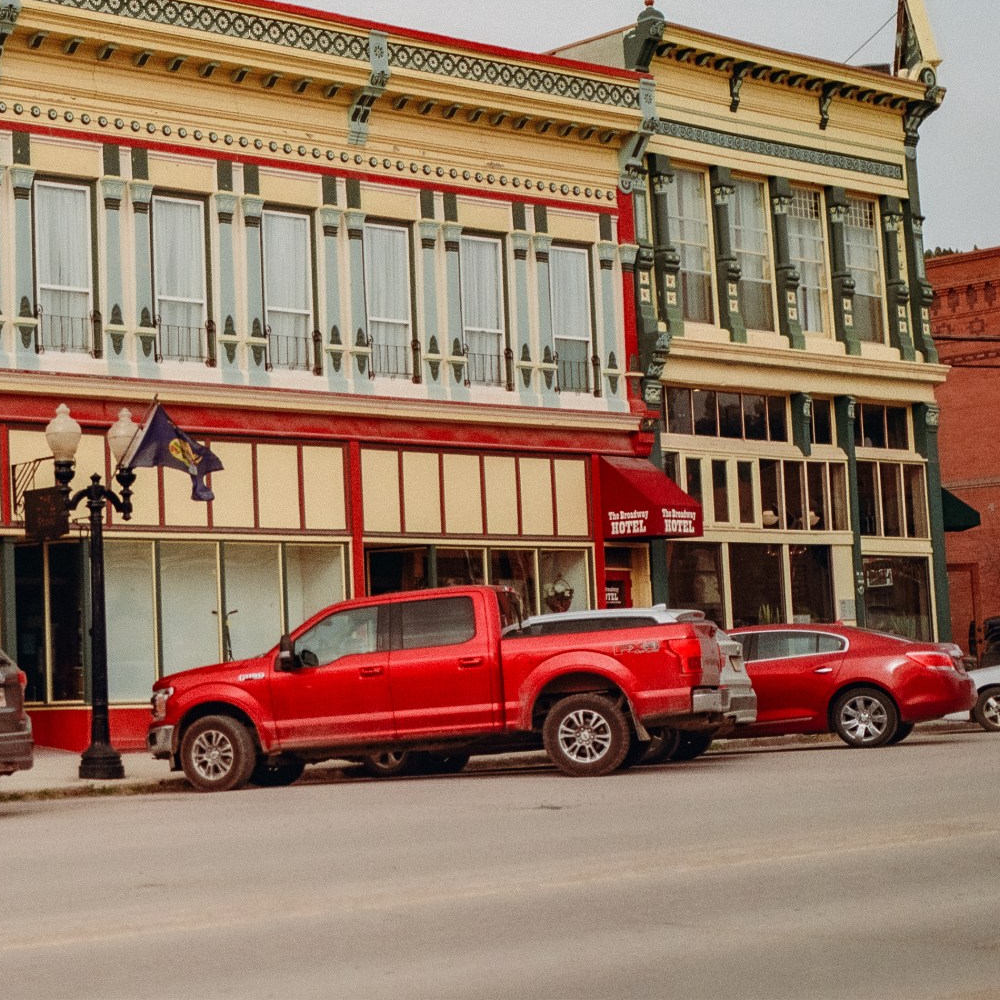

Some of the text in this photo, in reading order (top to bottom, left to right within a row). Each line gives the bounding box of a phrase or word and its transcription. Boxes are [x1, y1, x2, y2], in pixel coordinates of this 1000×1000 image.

[608, 510, 649, 521] The Broadway
[661, 508, 697, 520] The Broadway
[611, 520, 647, 535] HOTEL
[664, 519, 695, 533] HOTEL
